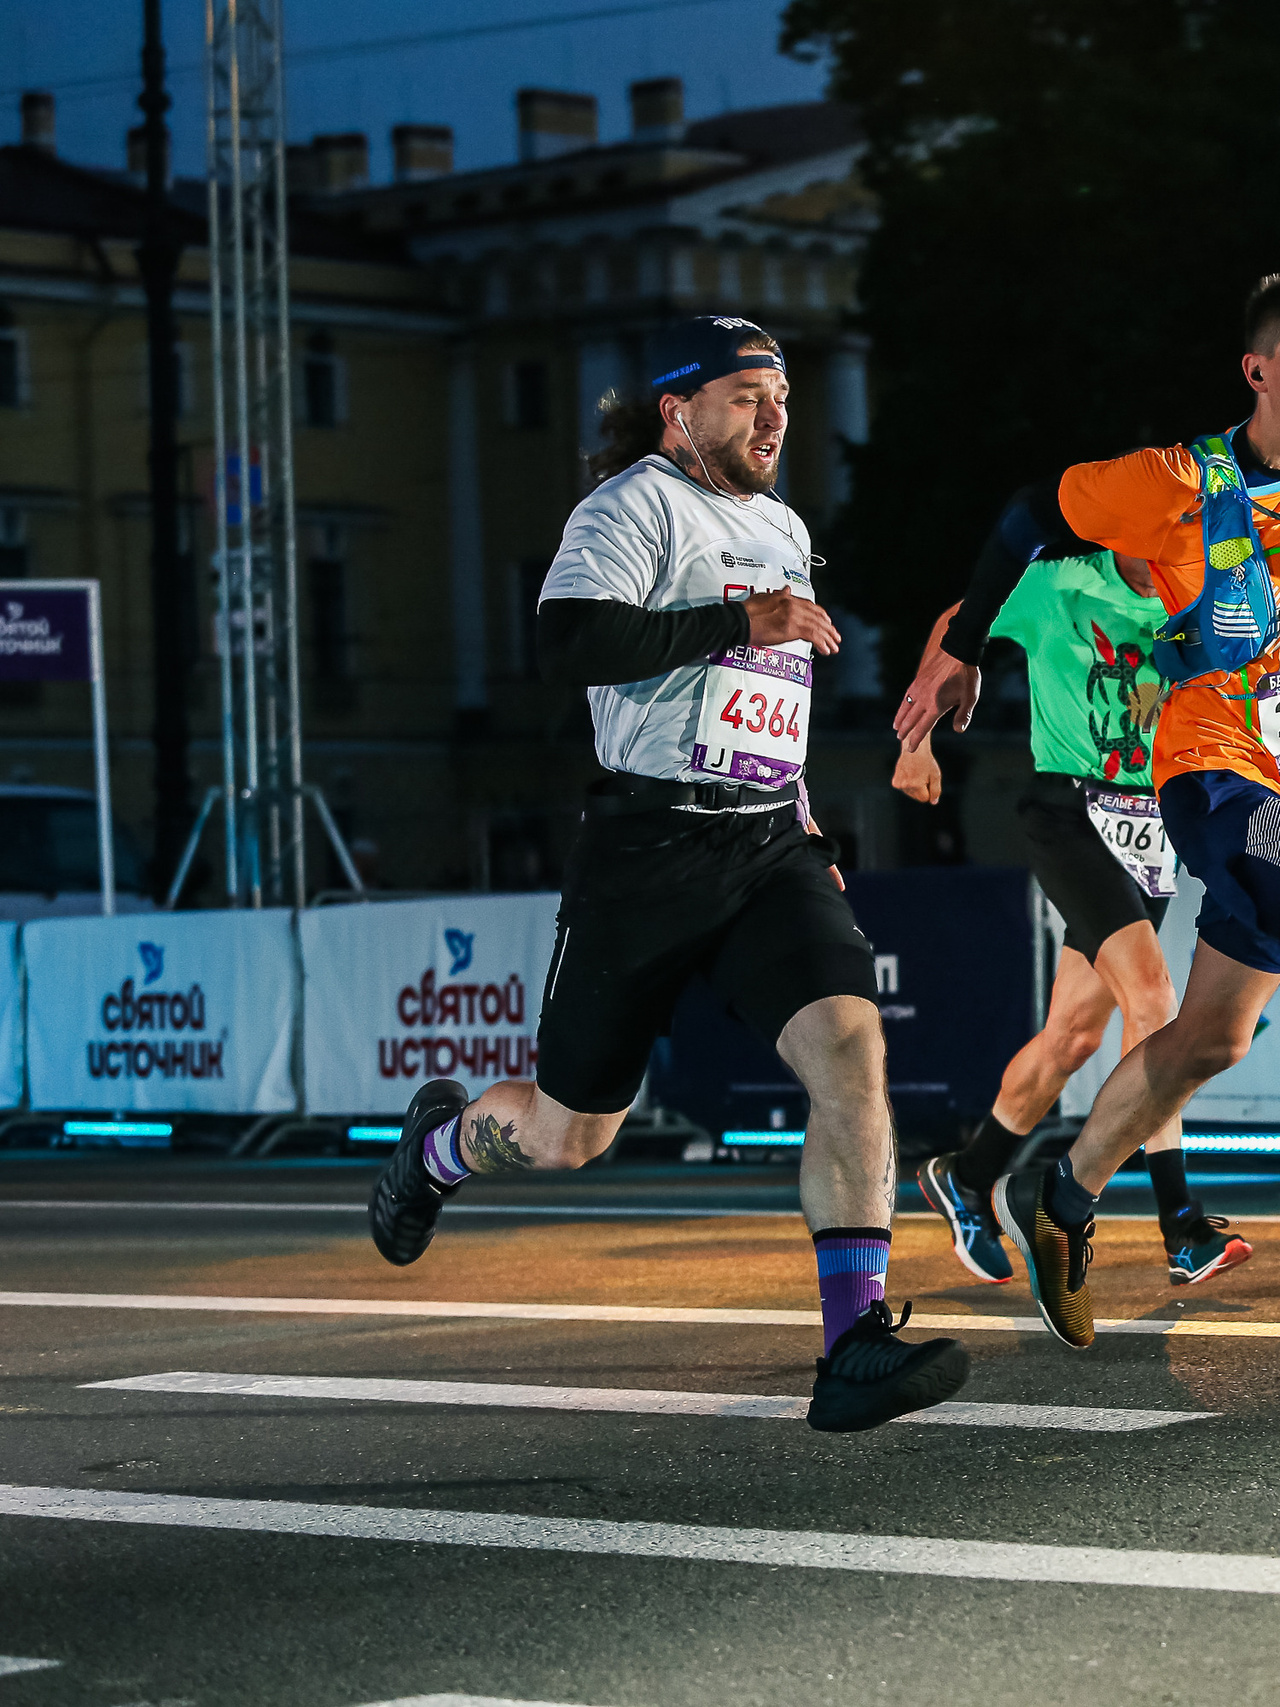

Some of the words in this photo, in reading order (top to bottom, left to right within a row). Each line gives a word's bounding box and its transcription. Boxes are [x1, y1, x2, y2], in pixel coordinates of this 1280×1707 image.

[720, 689, 800, 742] 4364
[710, 748, 726, 768] J
[1097, 794, 1134, 811] БЕЛЫЕ
